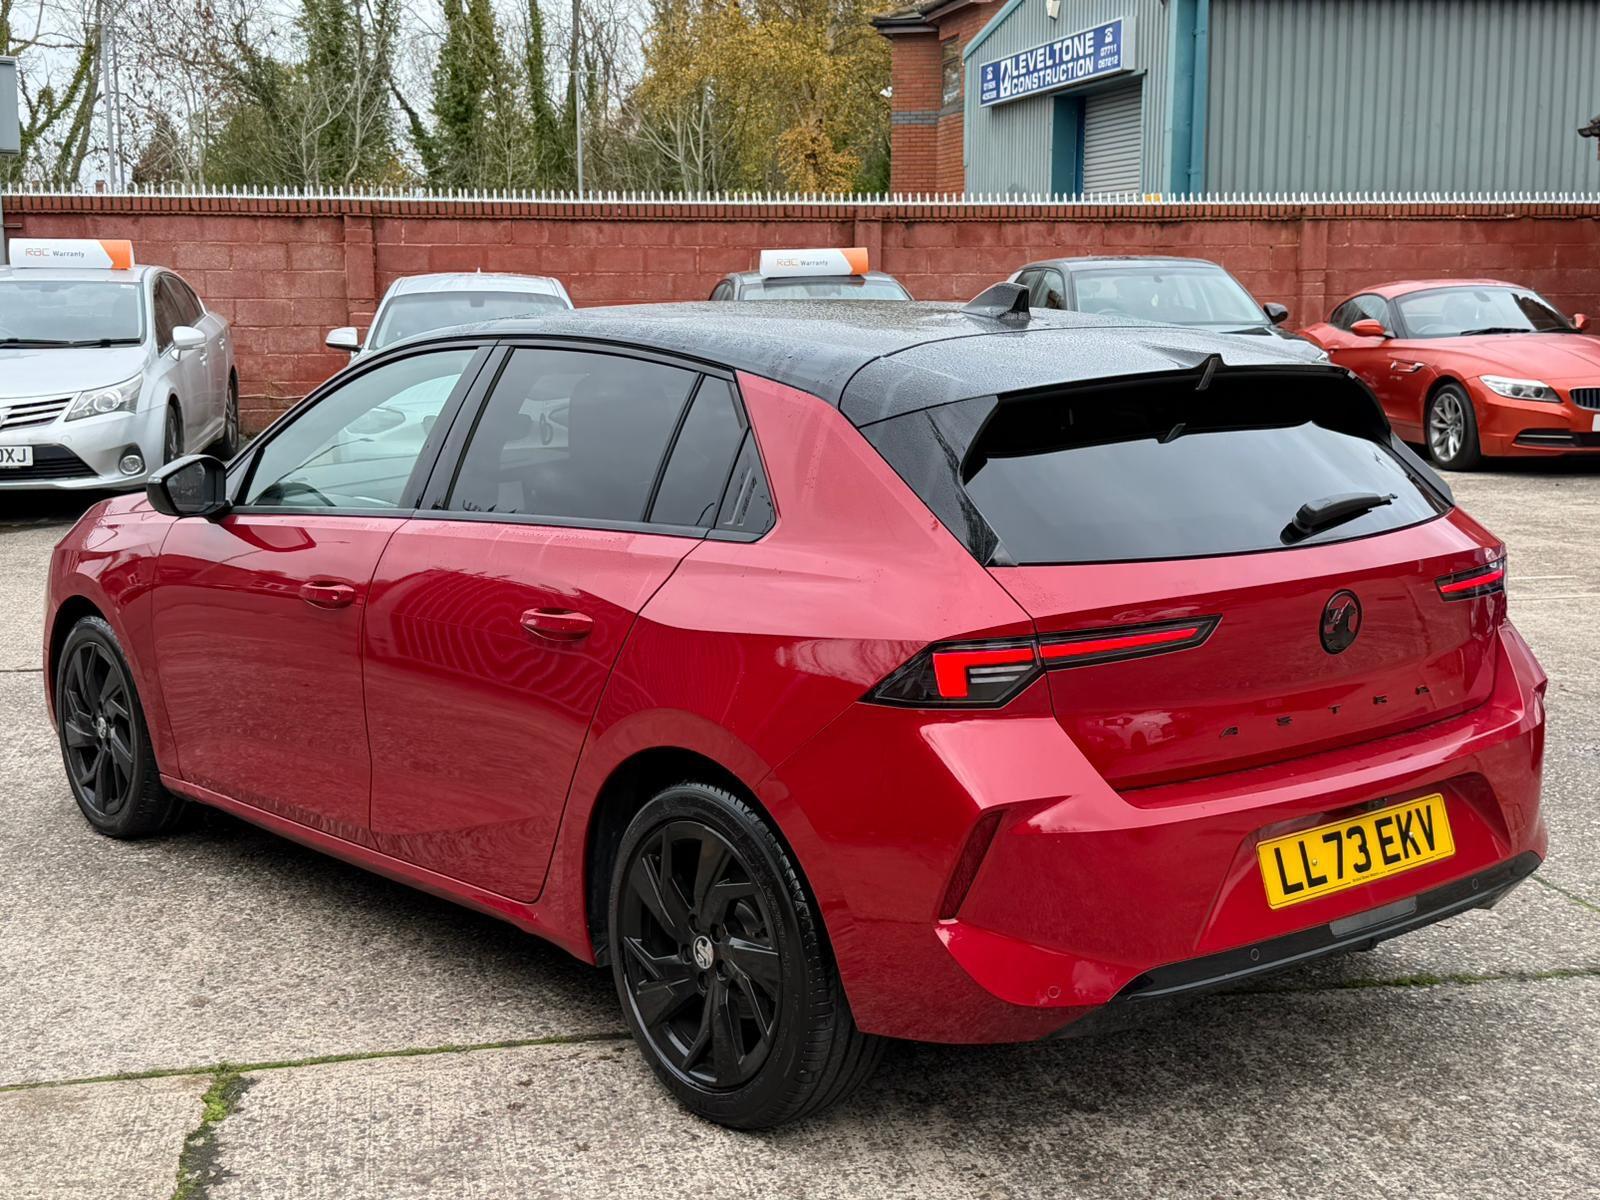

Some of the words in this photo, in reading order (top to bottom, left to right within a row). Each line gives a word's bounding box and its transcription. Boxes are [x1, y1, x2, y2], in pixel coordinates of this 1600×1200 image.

[1011, 56, 1094, 95] CONSTRUCTION
[52, 250, 85, 258] Warranty
[800, 259, 828, 267] Warranty
[1219, 684, 1430, 738] ASTRA
[1274, 825, 1372, 895] LL73
[1375, 805, 1435, 865] EKV
